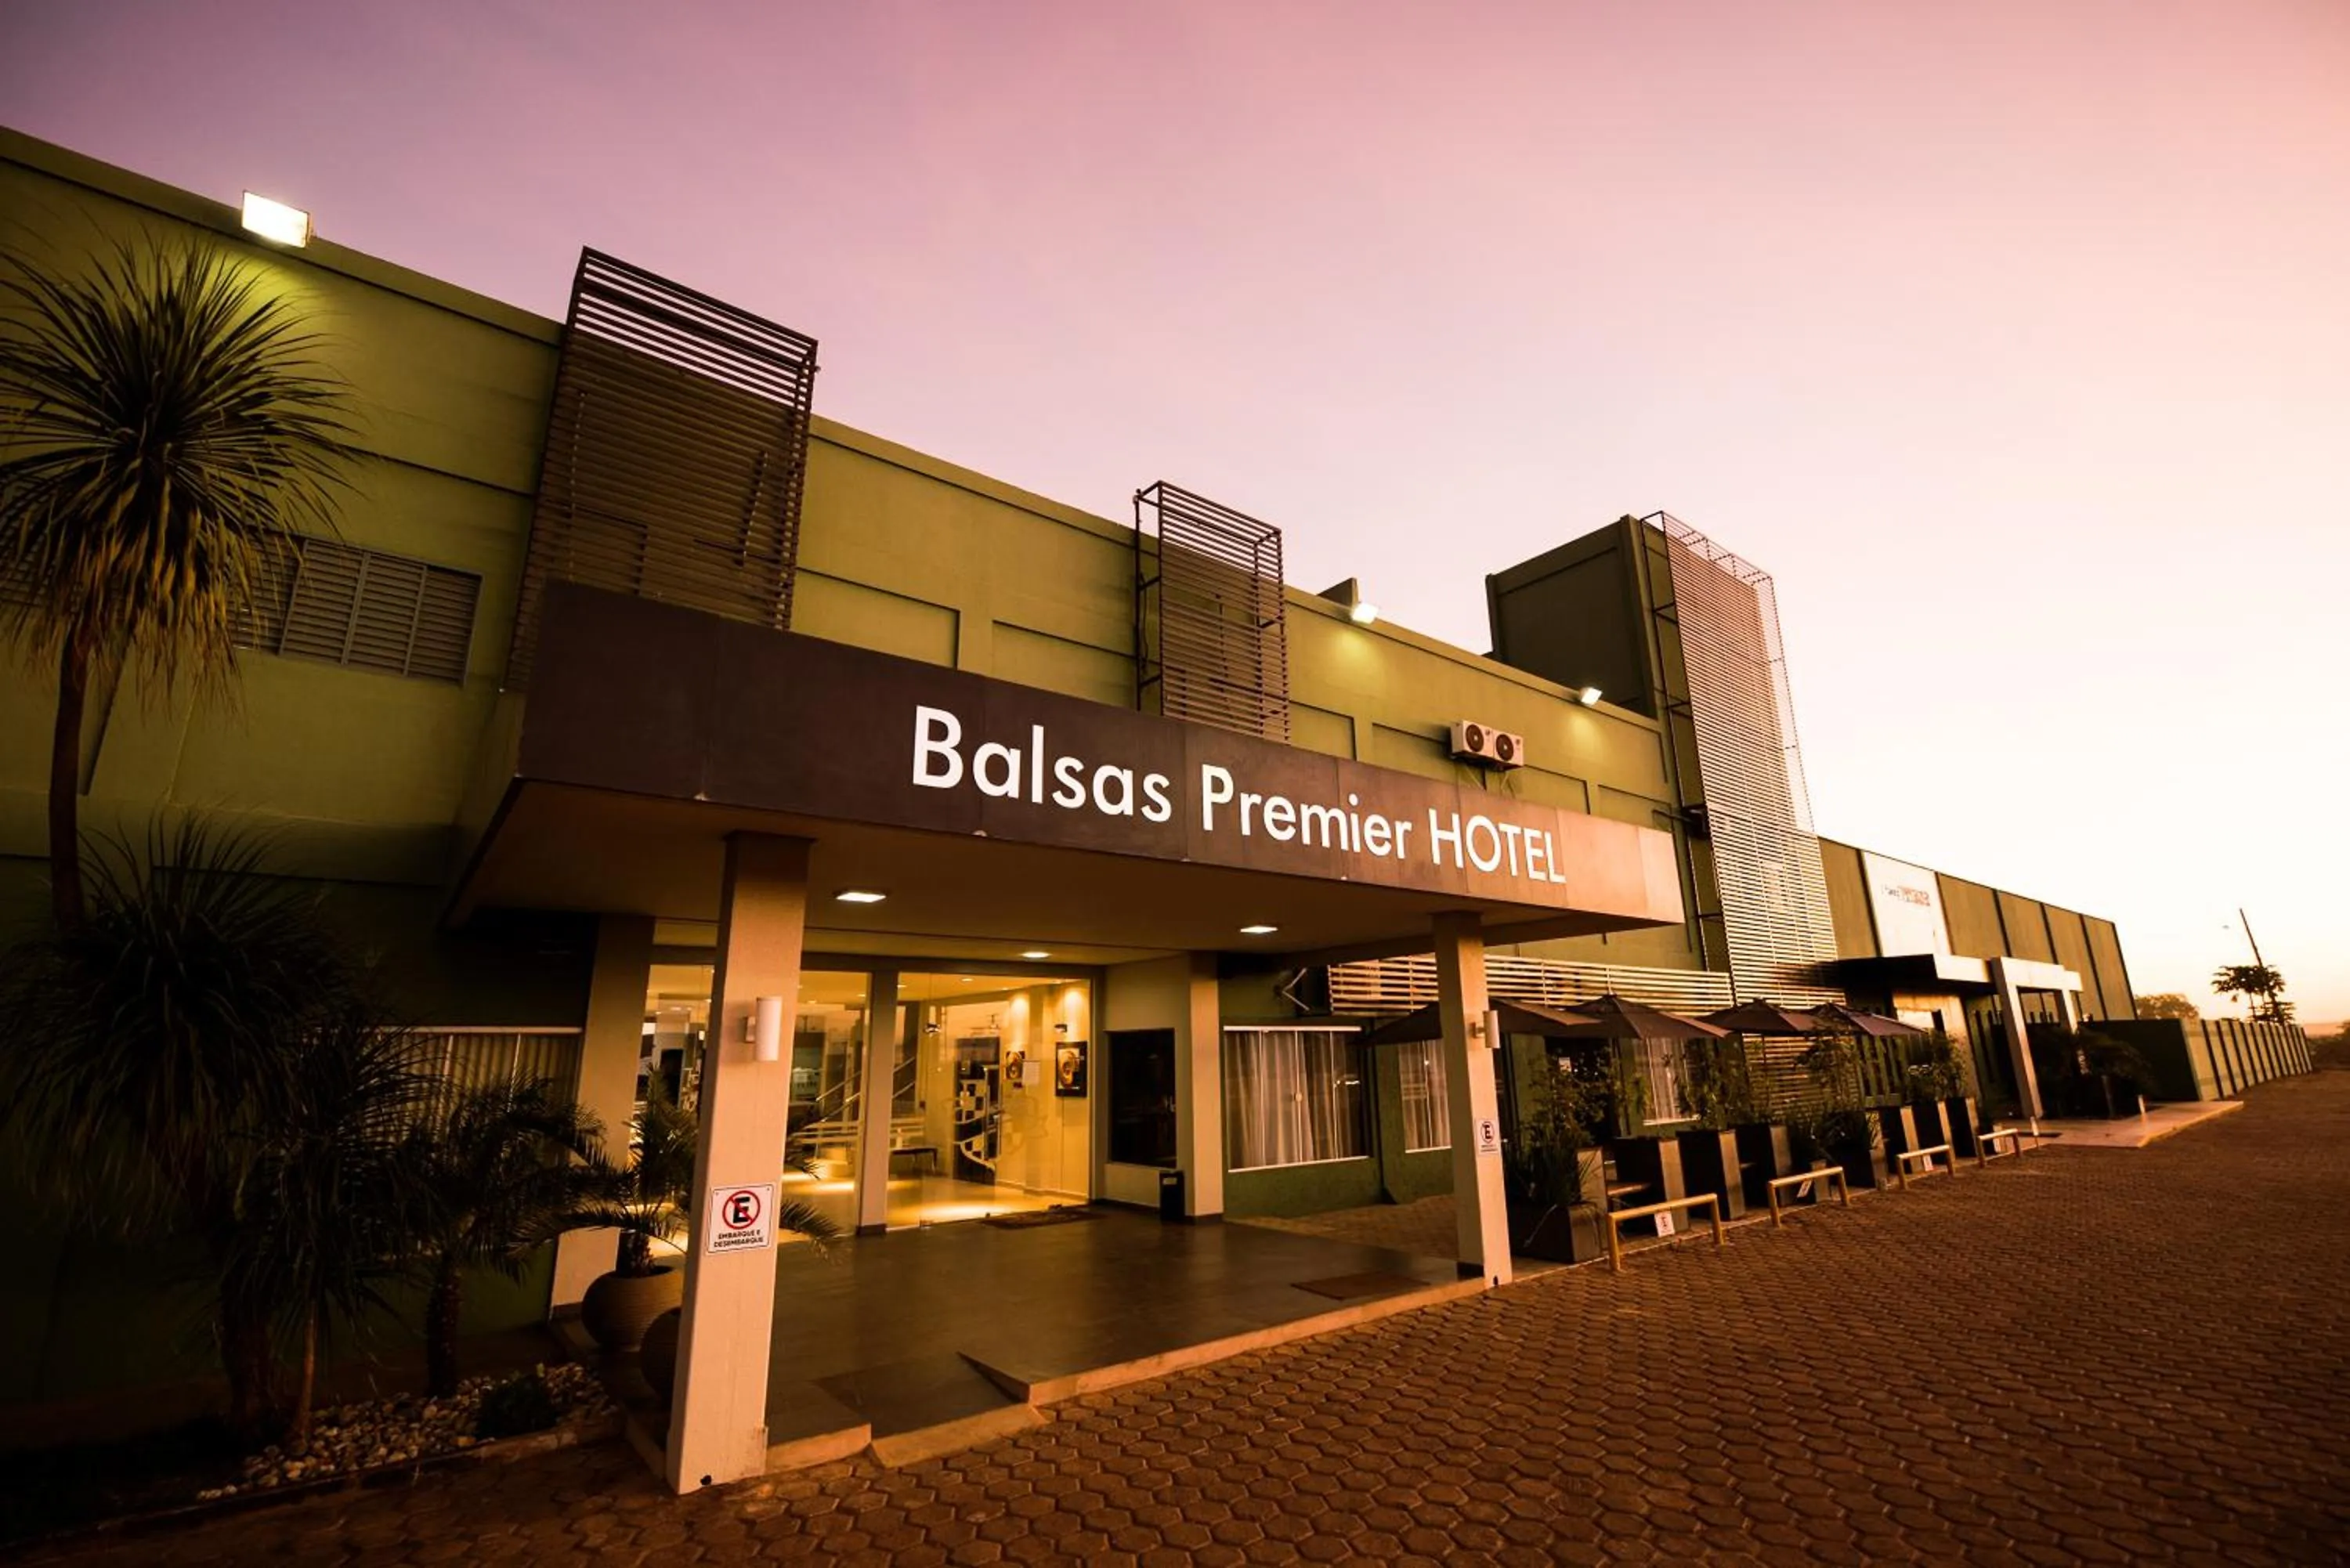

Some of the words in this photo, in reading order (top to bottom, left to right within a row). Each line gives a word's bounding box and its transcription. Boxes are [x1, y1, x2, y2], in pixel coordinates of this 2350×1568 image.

[913, 706, 1172, 823] Balsas
[1202, 763, 1412, 860] Premier
[1428, 808, 1566, 883] HOTEL
[733, 1196, 750, 1223] E
[718, 1230, 754, 1239] EMBARQUE
